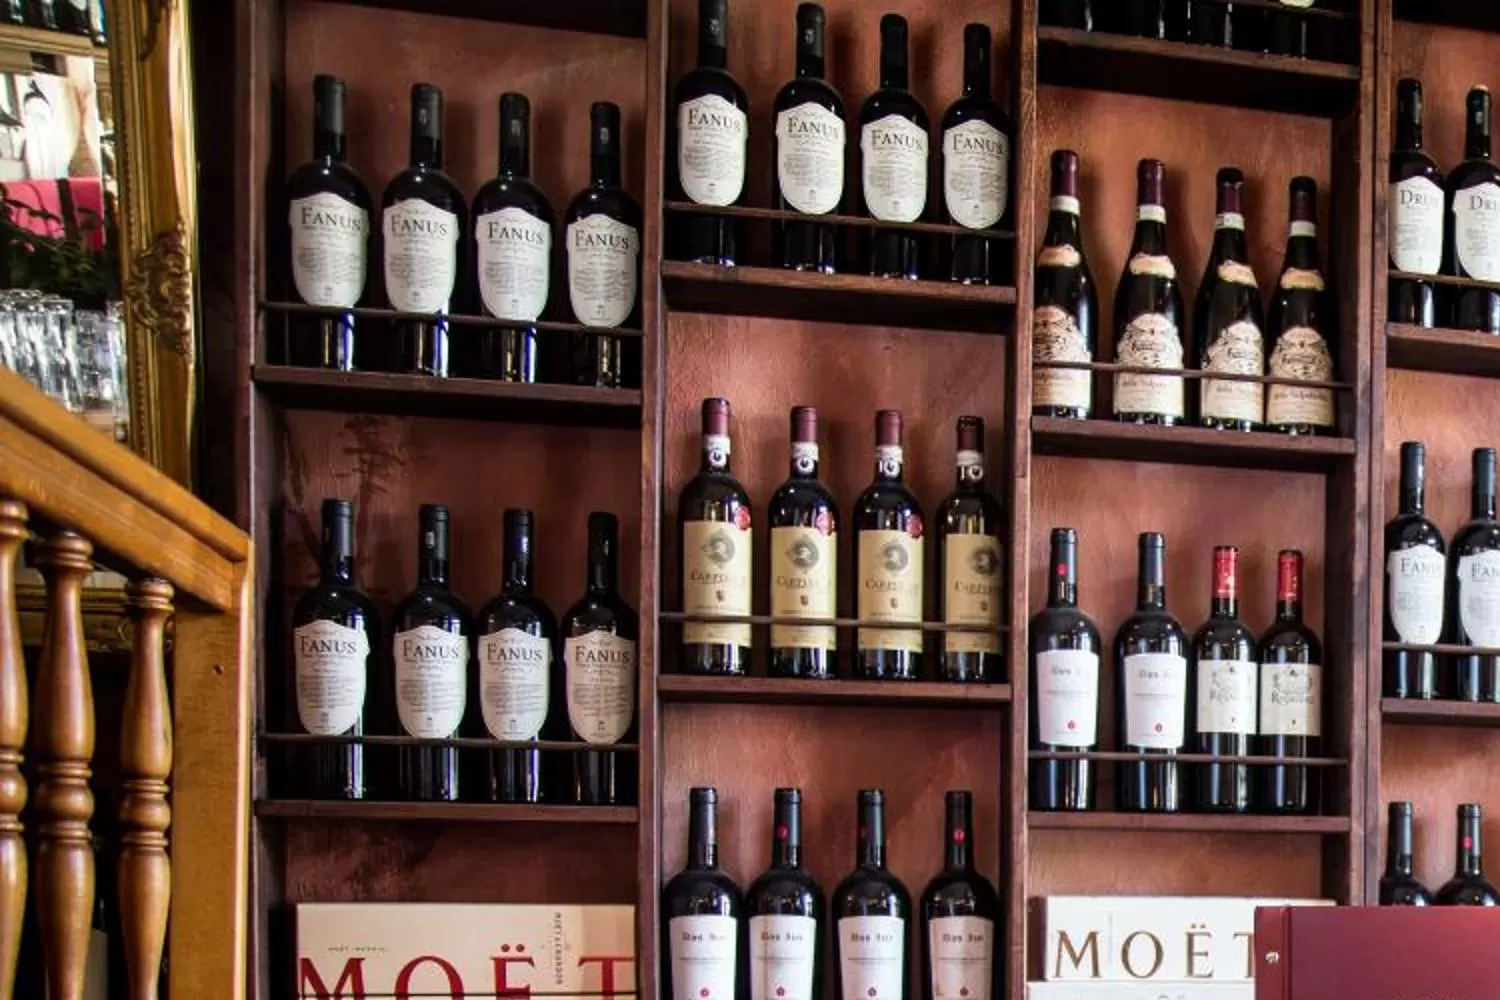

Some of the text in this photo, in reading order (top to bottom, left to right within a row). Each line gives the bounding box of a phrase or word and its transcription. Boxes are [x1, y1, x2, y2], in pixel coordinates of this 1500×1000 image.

[688, 107, 741, 133] FANUS
[301, 206, 362, 231] FANUS
[391, 214, 448, 237] FANUS
[487, 221, 545, 245] FANUS
[575, 229, 630, 250] FANUS
[300, 635, 357, 655] FANUS
[403, 639, 460, 658] FANUS
[487, 642, 543, 662] FANUS
[575, 645, 631, 664] FANUS
[1055, 923, 1254, 979] MOËT
